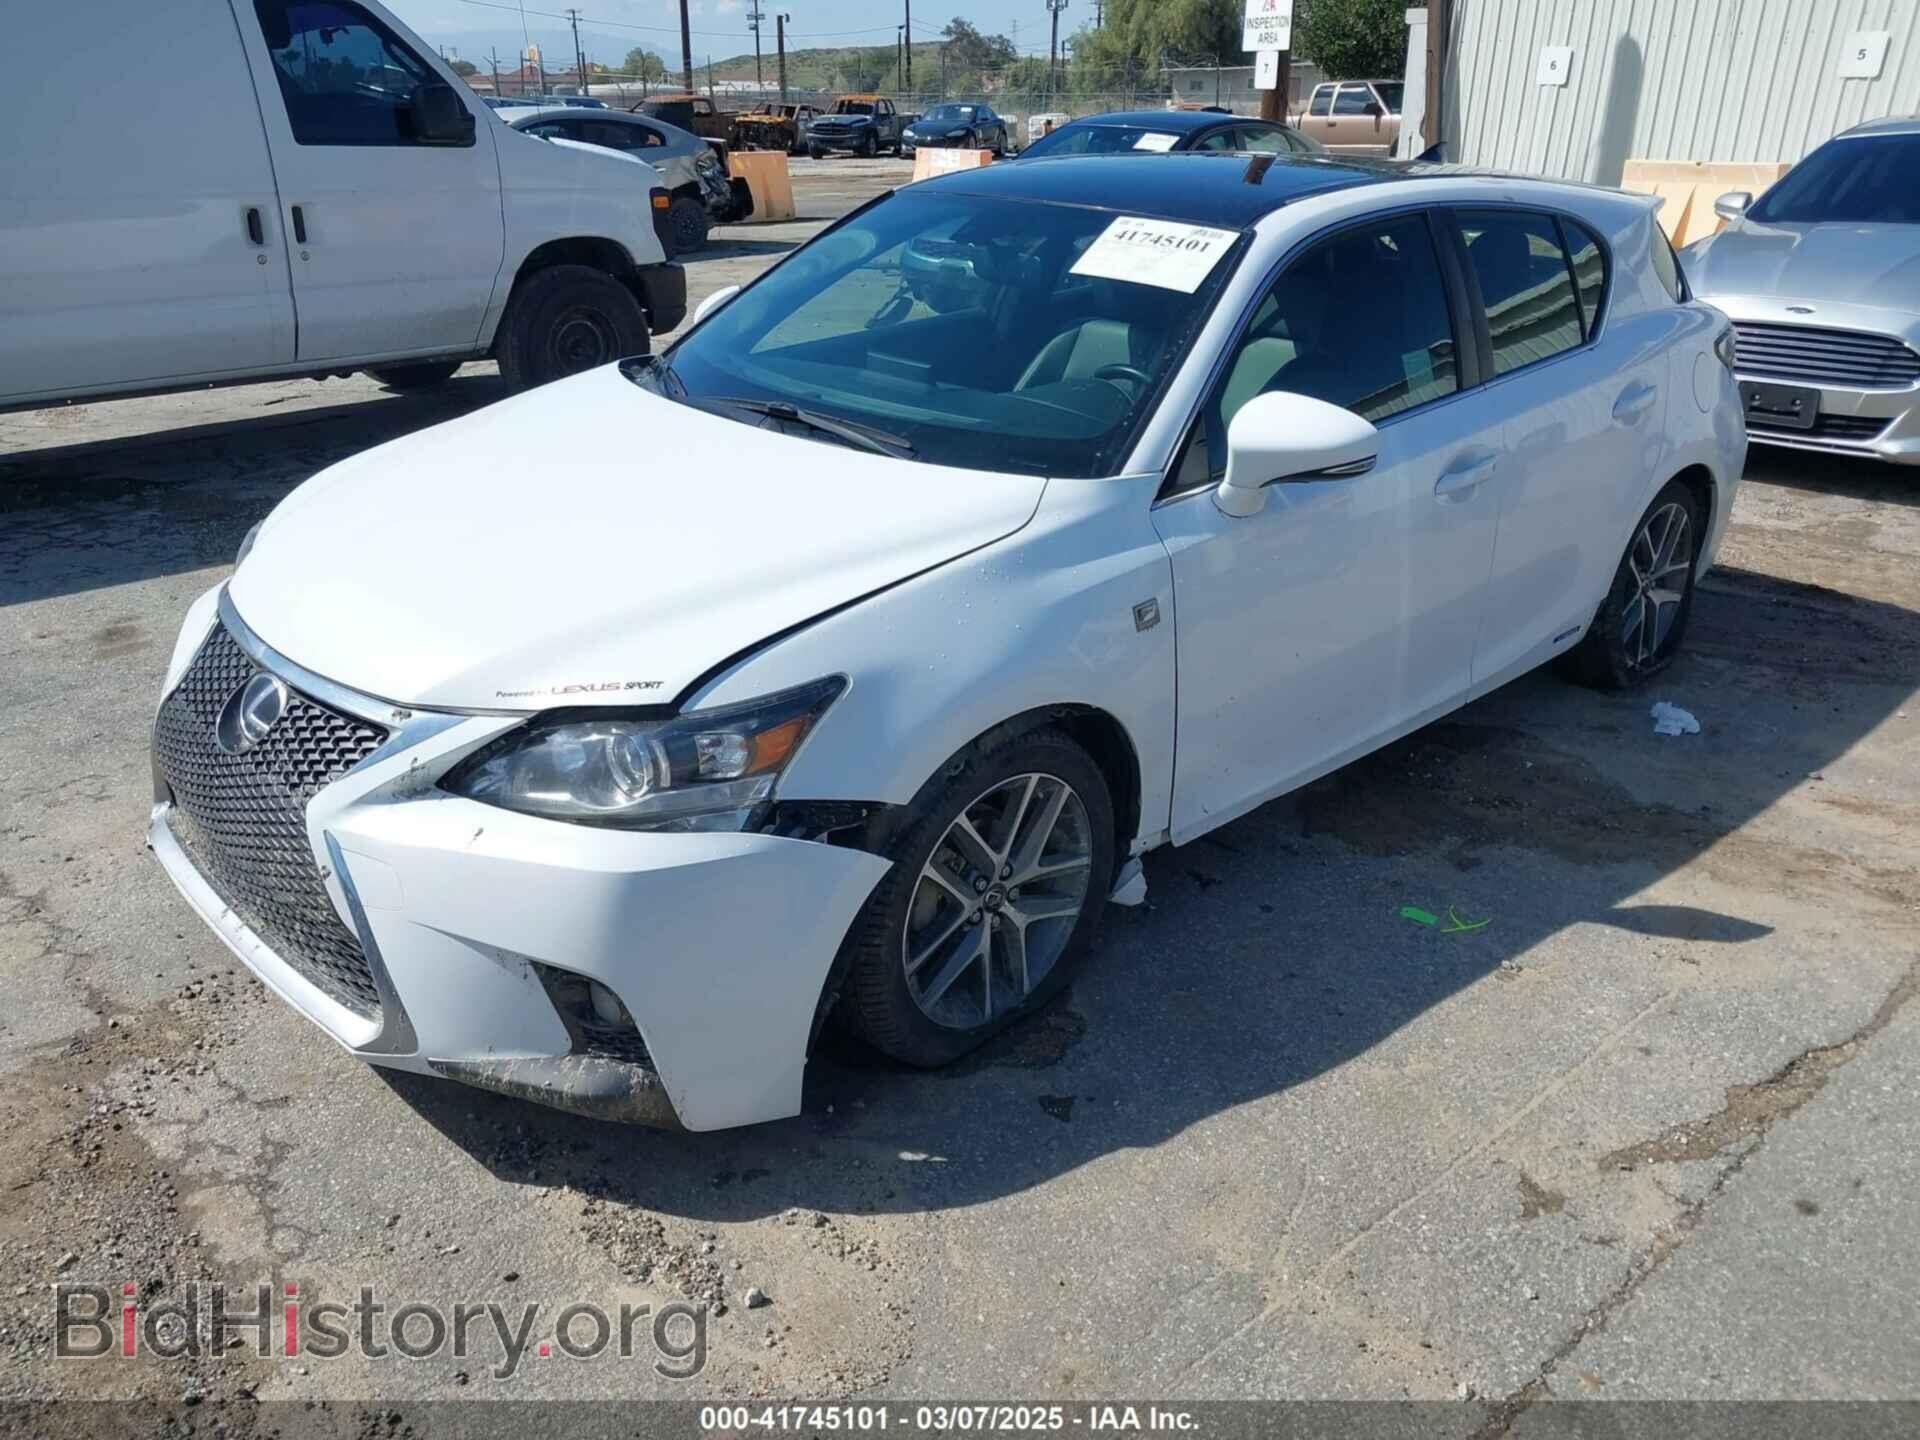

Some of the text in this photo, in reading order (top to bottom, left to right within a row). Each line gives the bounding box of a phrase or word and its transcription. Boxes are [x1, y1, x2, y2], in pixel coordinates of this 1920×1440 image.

[1247, 16, 1289, 28] INSPECTION
[1258, 32, 1278, 43] AREA
[1857, 49, 1866, 60] 5
[1550, 61, 1557, 70] 6
[1113, 230, 1212, 252] 41745101
[551, 682, 620, 696] LEXUS
[624, 680, 664, 691] SPORT
